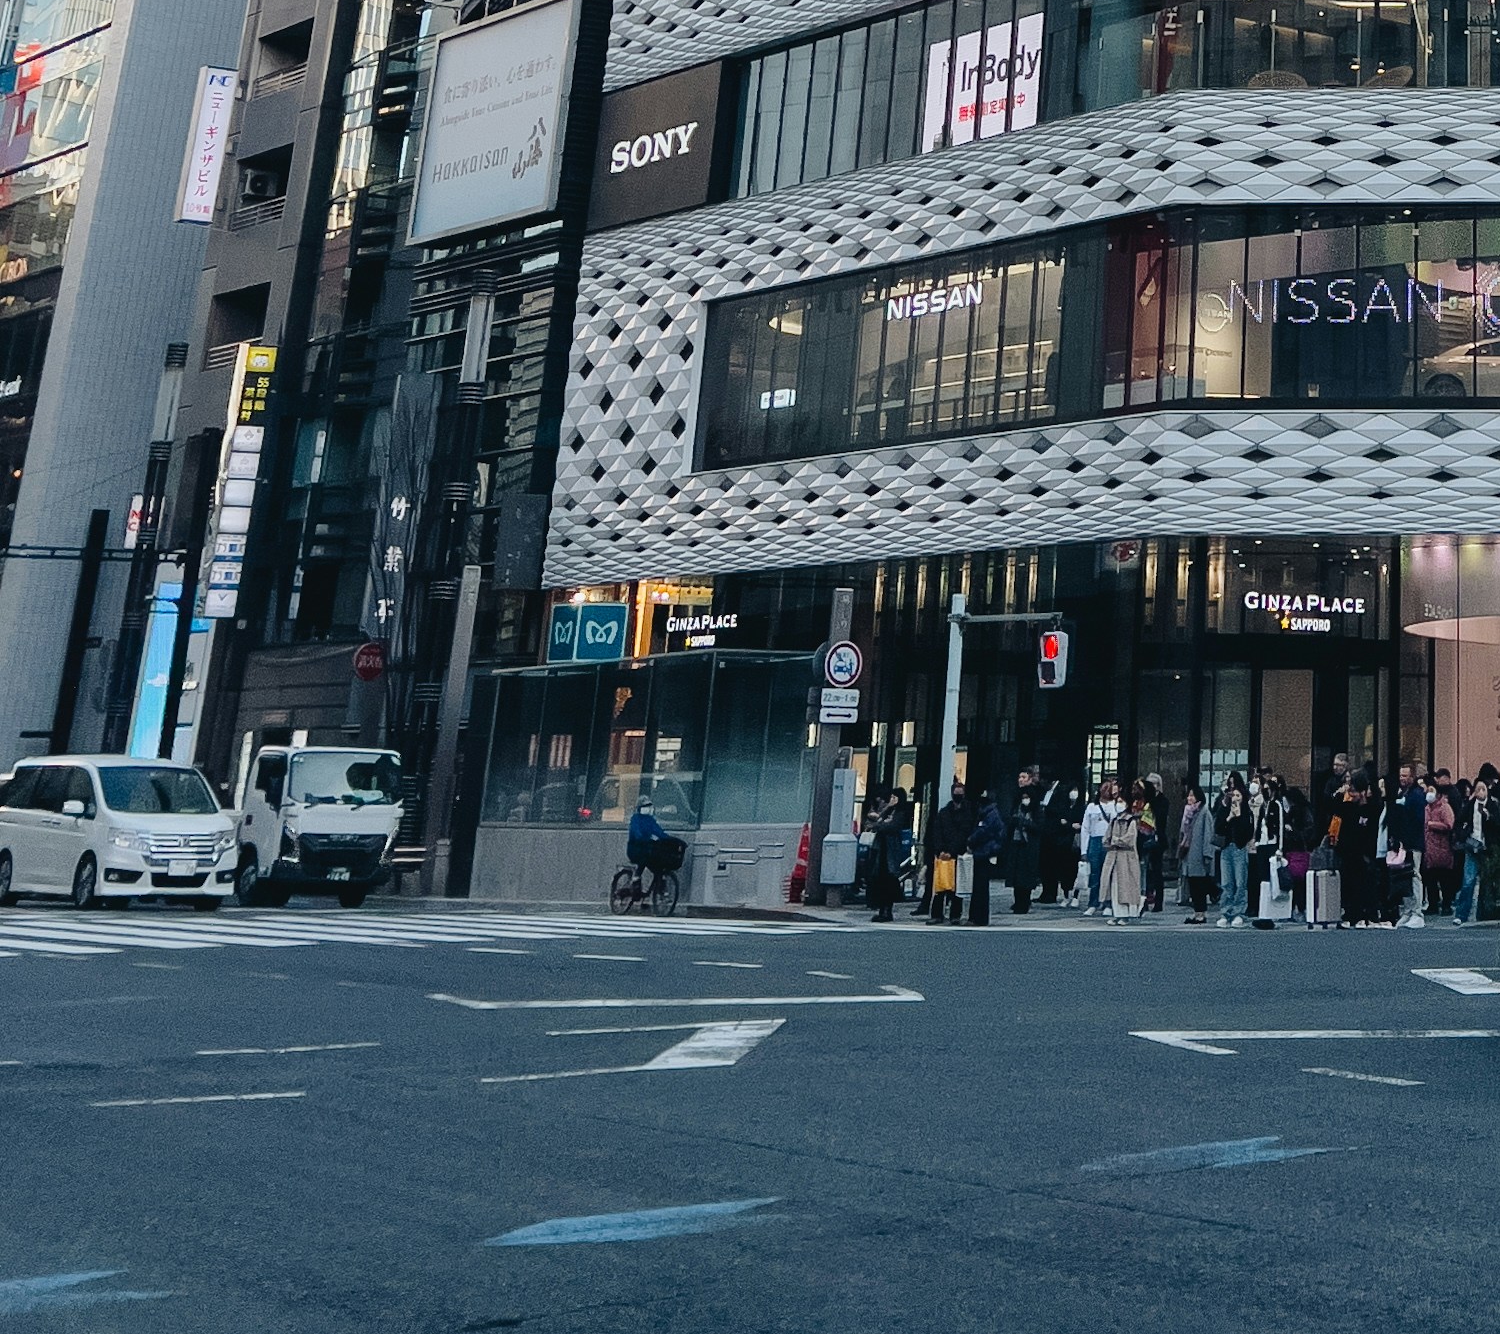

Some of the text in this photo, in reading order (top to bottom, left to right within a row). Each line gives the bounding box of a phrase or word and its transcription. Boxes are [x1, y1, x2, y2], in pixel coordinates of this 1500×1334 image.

[961, 44, 1042, 92] InBody
[194, 92, 224, 196] ニューギンザビル
[610, 121, 697, 173] SONY
[887, 281, 982, 320] NISSAN
[1229, 278, 1443, 325] NISSAN
[666, 614, 738, 632] GINZA PLACE
[1244, 591, 1365, 613] GINZA PLACE
[1290, 618, 1331, 632] SAPPORO
